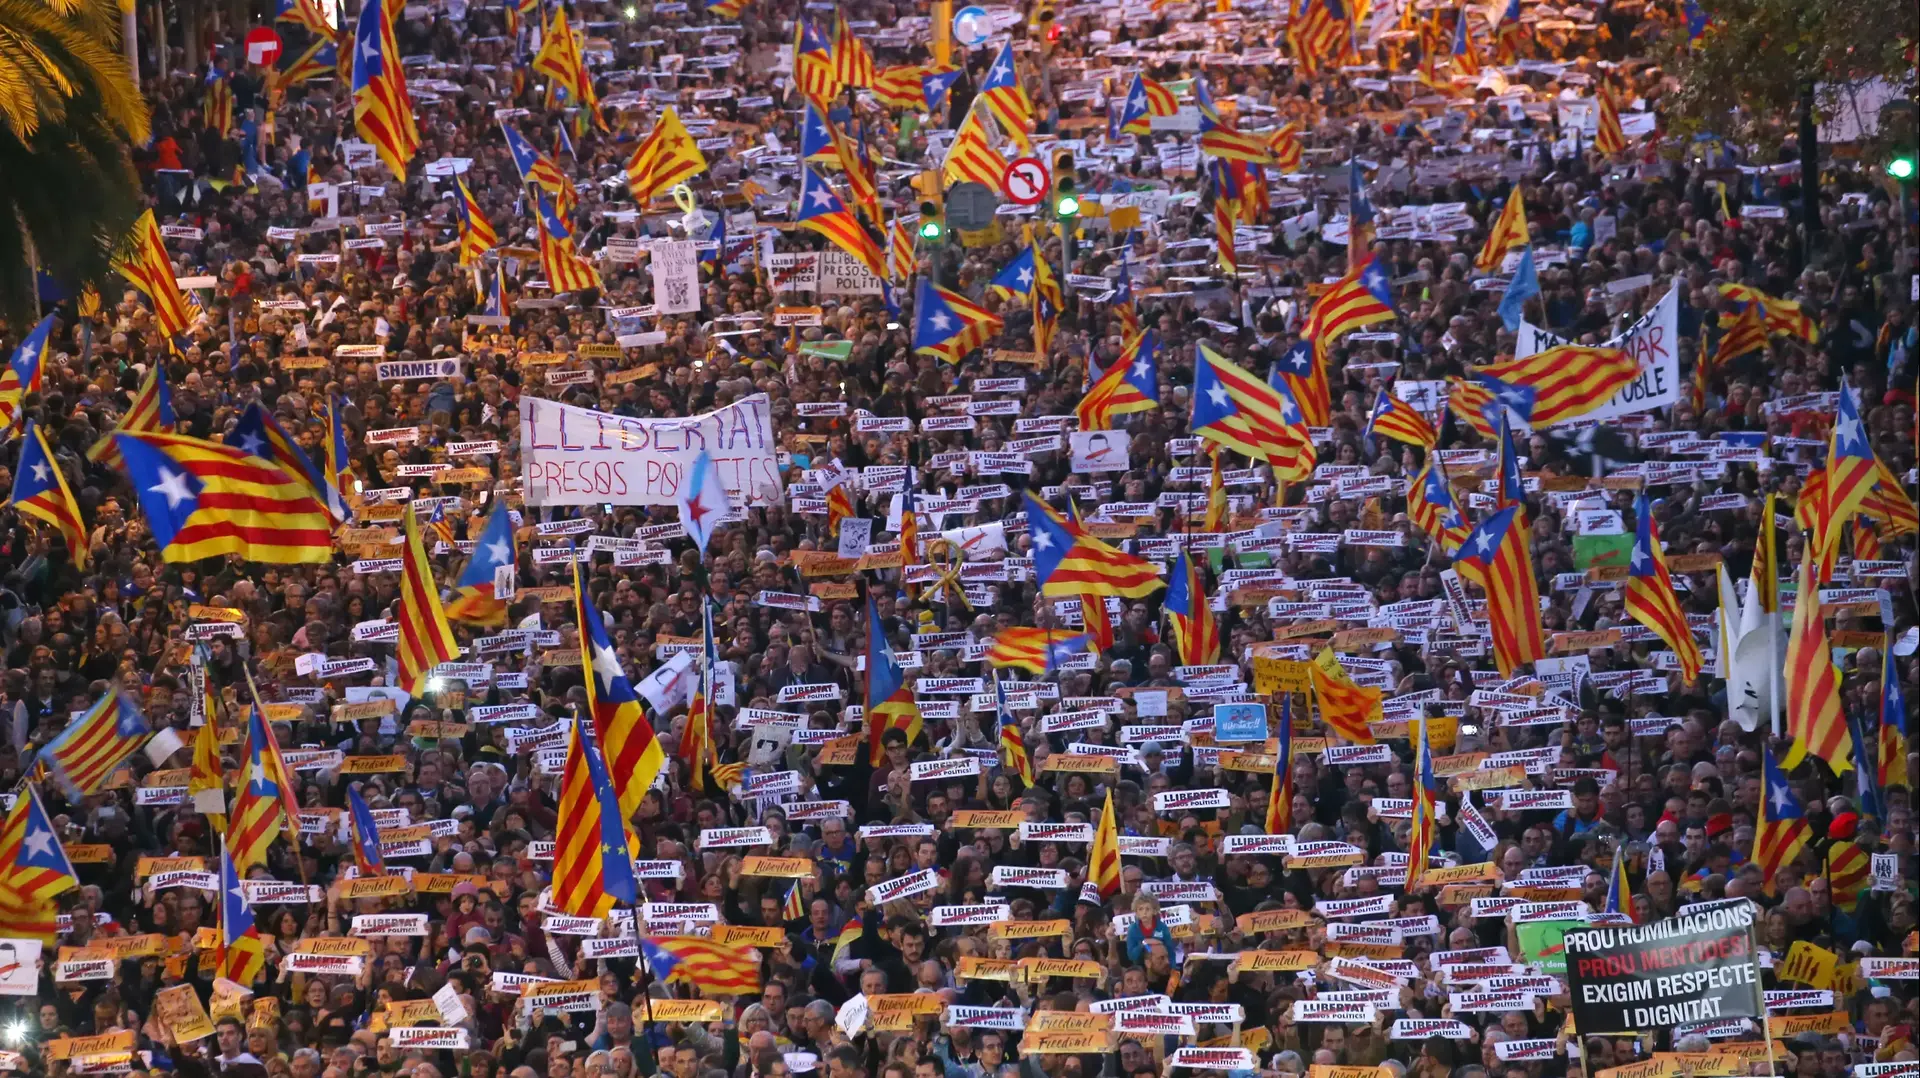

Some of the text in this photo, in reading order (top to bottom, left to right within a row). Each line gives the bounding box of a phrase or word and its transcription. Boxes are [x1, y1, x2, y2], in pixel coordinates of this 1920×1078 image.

[824, 266, 869, 276] PRESOS
[381, 363, 438, 377] SHAME!
[529, 461, 627, 498] PRESOS
[784, 685, 833, 695] LLIBERTAT
[479, 706, 528, 715] LLIBERTAT
[1048, 713, 1099, 724] LLIBERTAT
[1331, 748, 1383, 757] LLIBERTAT
[1164, 791, 1219, 802] LLIBERTAT
[1509, 792, 1563, 802] LLIBERTAT
[789, 803, 840, 812] LLIBERTAT
[968, 813, 1010, 826] Llibertat!
[1028, 825, 1084, 833] LLIBERTAT
[708, 830, 761, 840] LLIBERTAT
[1231, 837, 1286, 846] LLIBERTAT
[1001, 870, 1057, 878] LLIBERTAT
[878, 872, 928, 894] LLIBERTAT
[1150, 883, 1207, 892] LLIBERTAT
[652, 905, 710, 913] LLIBERTAT
[1327, 900, 1383, 910] LLIBERTAT
[1520, 905, 1577, 914] LLIBERTAT
[941, 906, 999, 917] LLIBERTAT
[361, 918, 418, 927] LLIBERTAT
[1005, 923, 1055, 935] Freedom!
[1336, 926, 1393, 936] LLIBERTAT
[1564, 905, 1752, 954] PROU HUMILIACIONS
[1578, 936, 1751, 977] PROU MENTIDES!
[1489, 978, 1549, 988] LLIBERTAT
[1582, 963, 1756, 1004] EXIGIM RESPECTE
[532, 994, 591, 1006] LLIBERTAT
[1460, 994, 1522, 1002] LLIBERTAT
[1100, 997, 1161, 1011] LLIBERTAT
[1303, 1004, 1365, 1012] LLIBERTAT
[956, 1009, 1015, 1020] LLIBERTAT
[1624, 997, 1722, 1027] I DIGNITAT
[1121, 1014, 1182, 1024] LLIBERTAT
[1400, 1021, 1460, 1030] LLIBERTAT
[399, 1030, 457, 1040] LLIBERTAT
[1039, 1037, 1093, 1050] Freedom!
